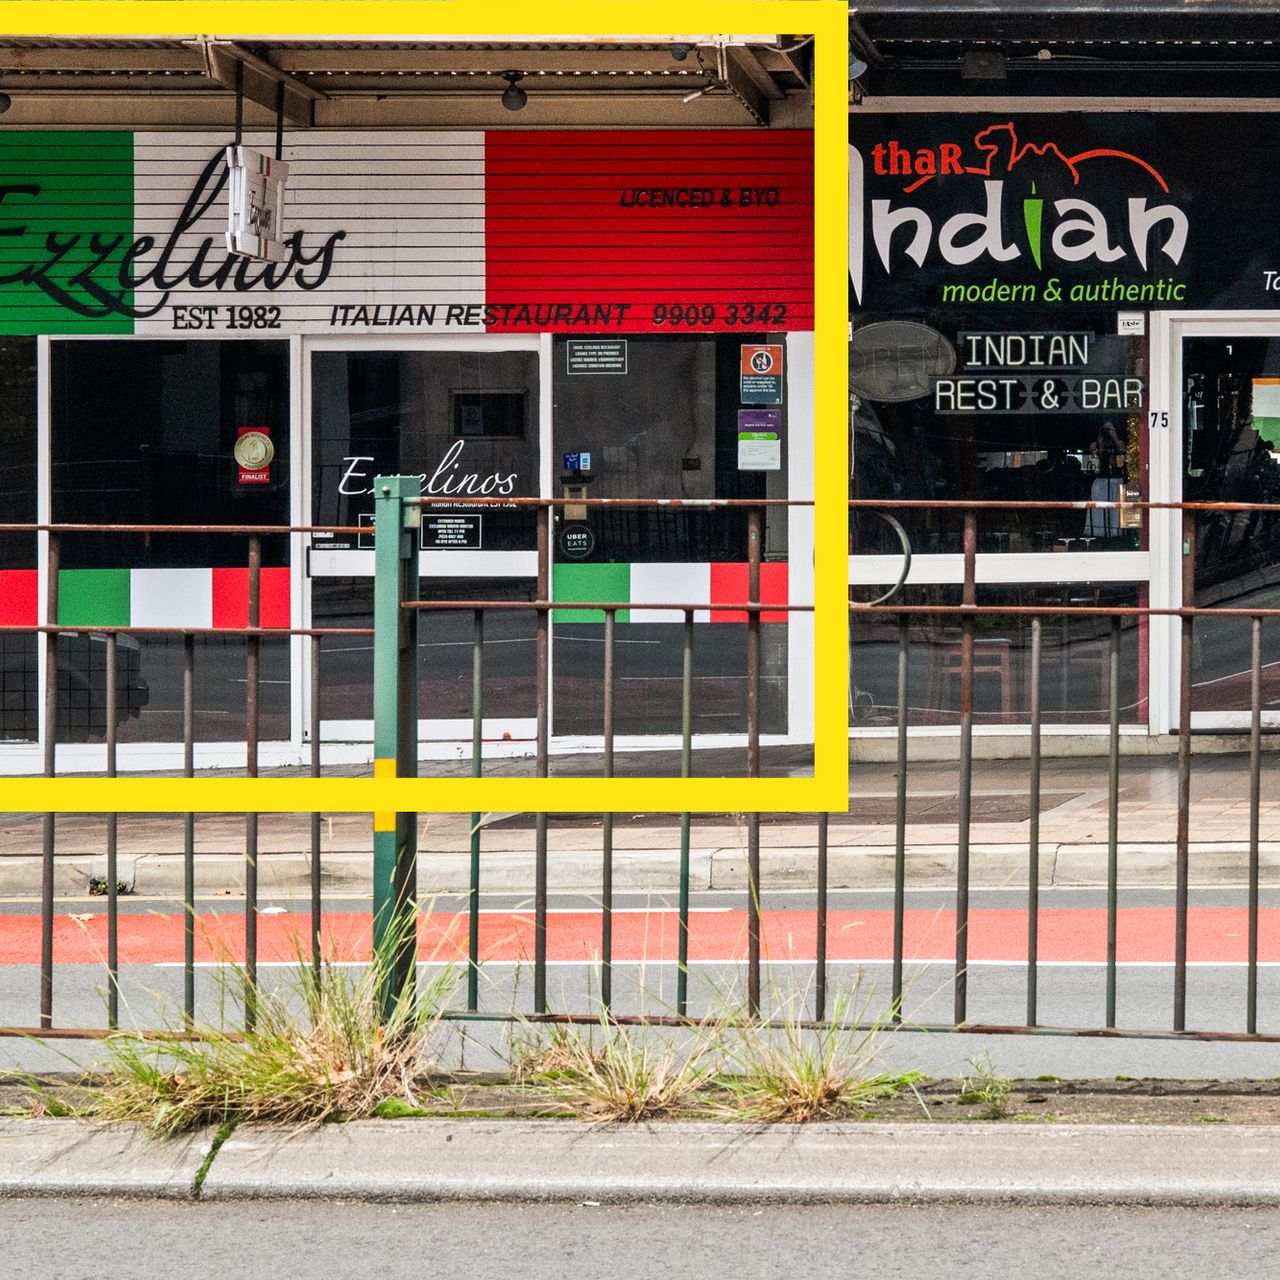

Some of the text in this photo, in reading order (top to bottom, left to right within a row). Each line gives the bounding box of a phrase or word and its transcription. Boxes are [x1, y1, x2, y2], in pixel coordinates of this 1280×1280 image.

[871, 141, 965, 176] thaR
[620, 187, 780, 208] LICENCED & BYO
[942, 277, 1187, 302] modern & authentic
[172, 305, 281, 330] EST 1982
[330, 303, 787, 327] ITALIAN RESTAURANT 9909 3342
[966, 335, 1089, 366] INDIAN
[936, 379, 1142, 410] REST & BAR
[1150, 412, 1169, 428] 75
[337, 440, 518, 495] Eelinos
